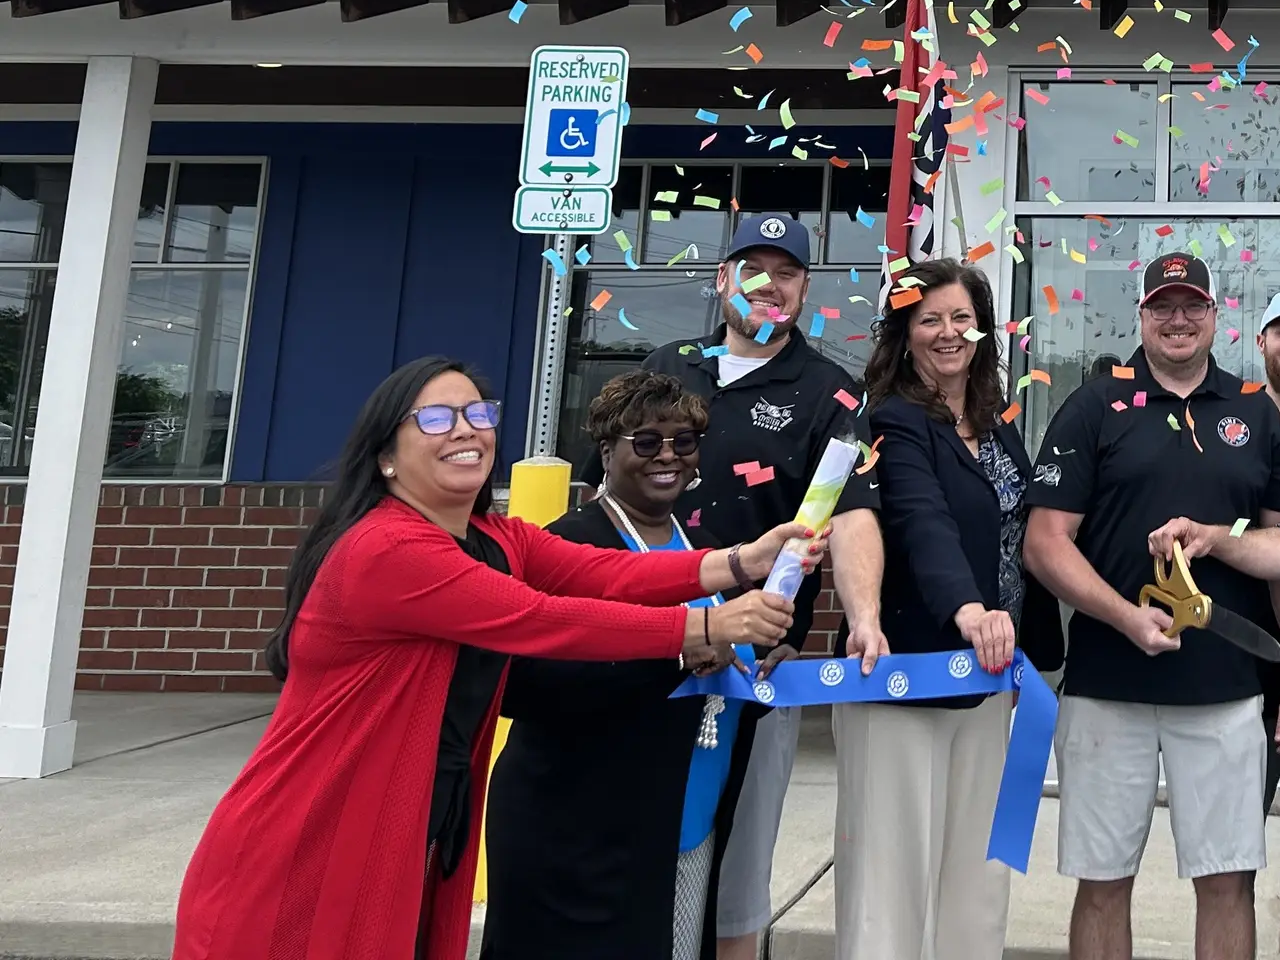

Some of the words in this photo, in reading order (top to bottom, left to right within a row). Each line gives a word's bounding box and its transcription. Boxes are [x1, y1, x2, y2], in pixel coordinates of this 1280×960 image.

[538, 61, 619, 79] RESERVED
[542, 86, 612, 102] PARKING
[551, 197, 581, 210] VAN
[531, 212, 595, 223] ACCESSIBLE
